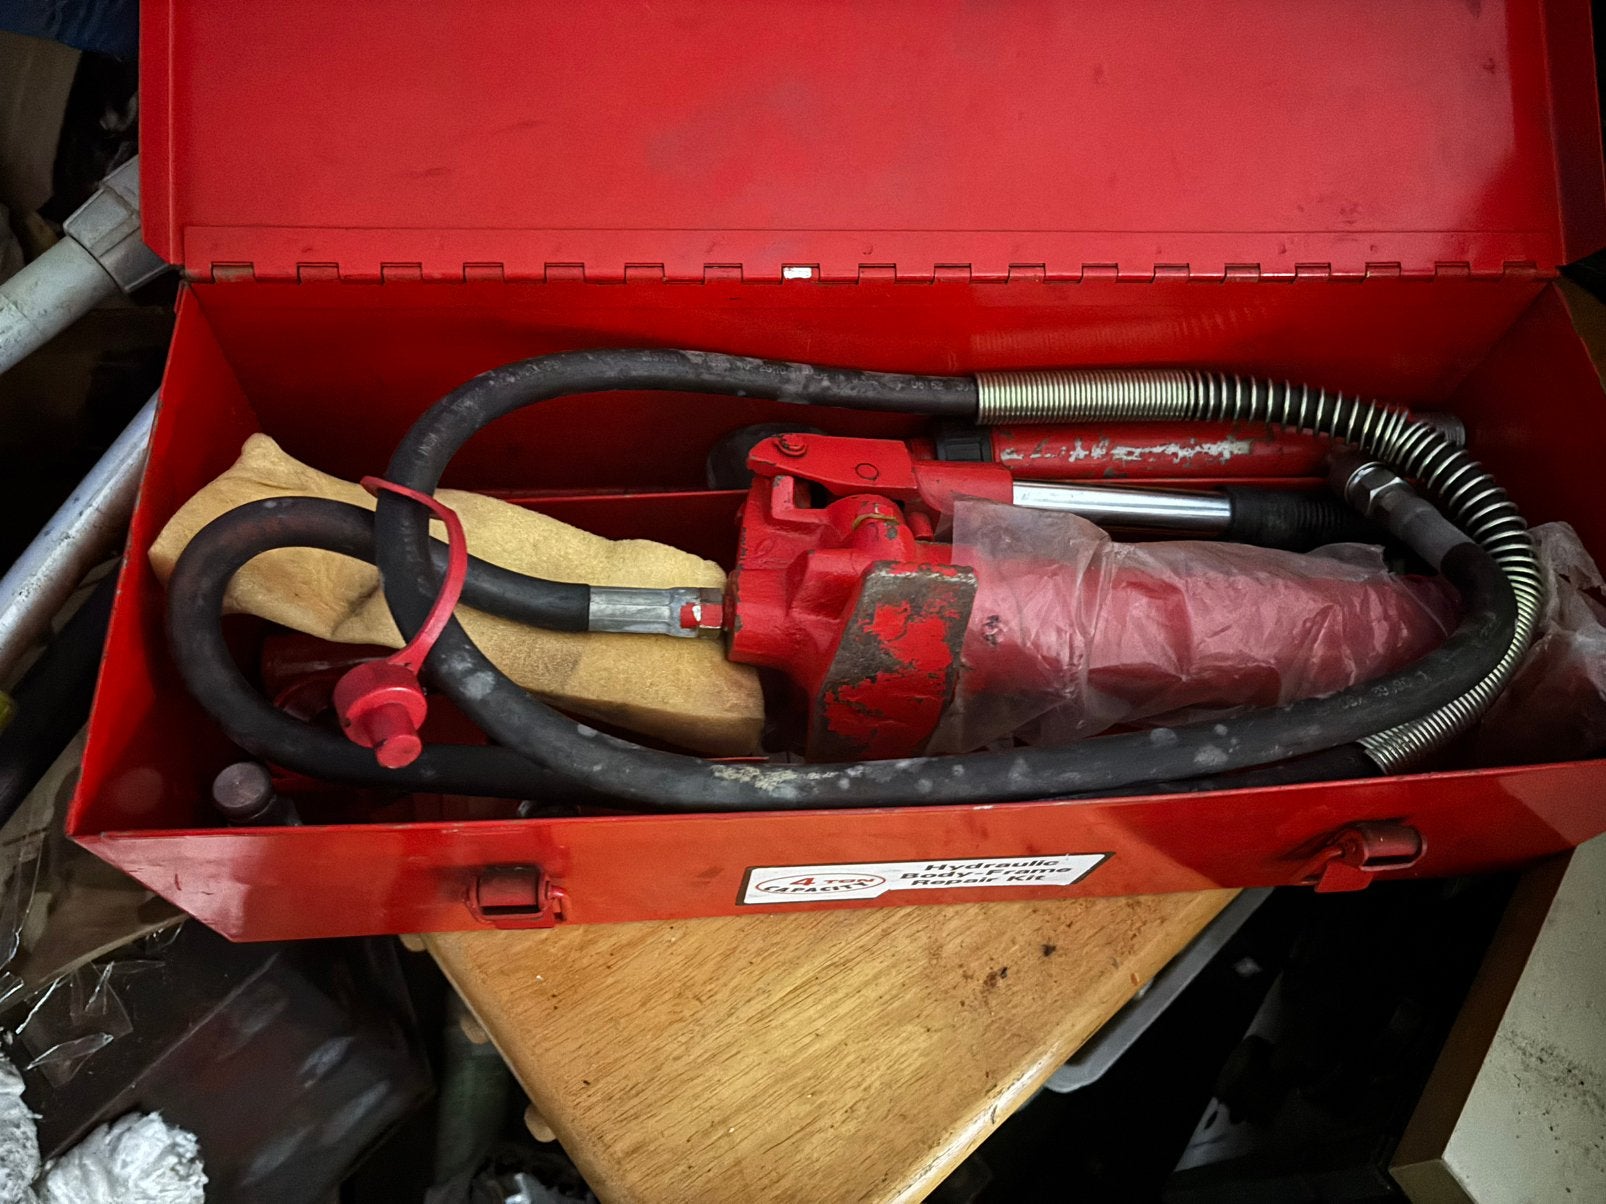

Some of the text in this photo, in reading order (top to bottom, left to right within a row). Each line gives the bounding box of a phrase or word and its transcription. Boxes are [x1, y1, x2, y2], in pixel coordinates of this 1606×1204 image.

[924, 859, 1060, 871] Hydraulic
[899, 866, 1073, 879] Body-Frame
[789, 877, 816, 886] 4
[910, 874, 1047, 886] Repair Kit
[763, 882, 869, 893] CAPACITY
